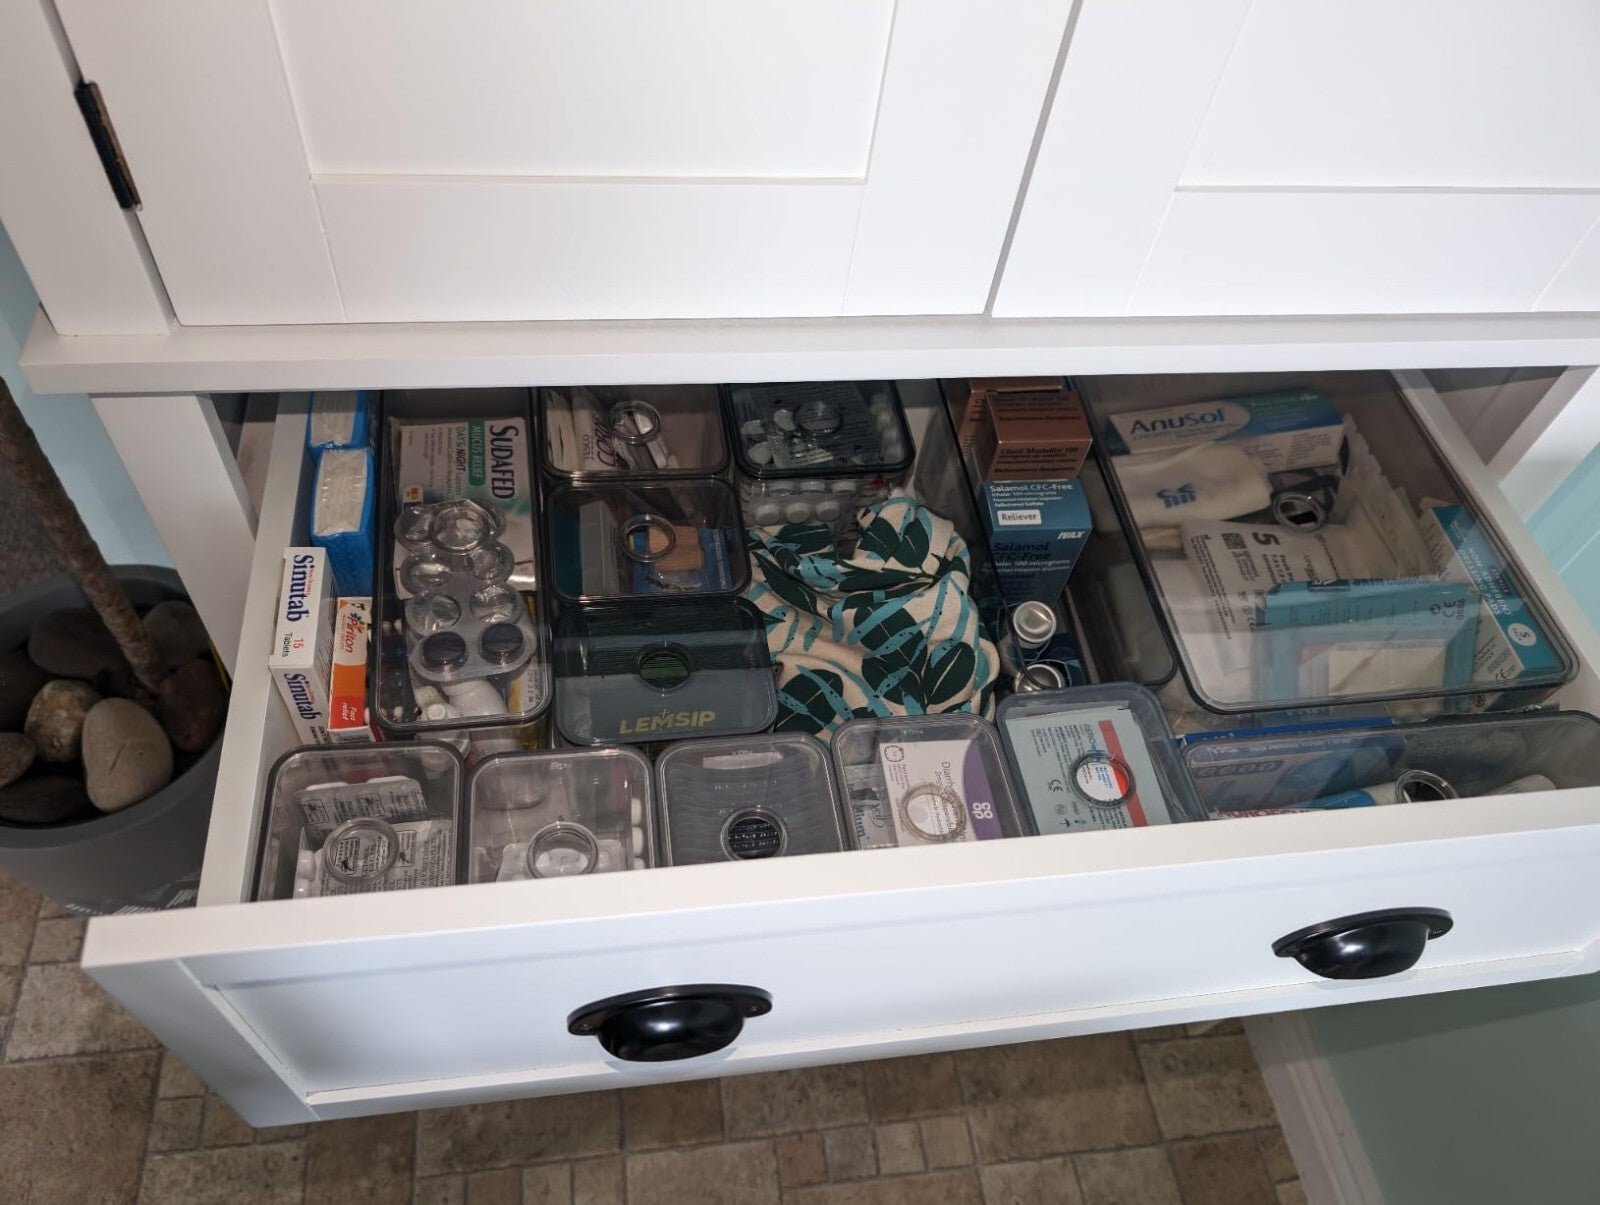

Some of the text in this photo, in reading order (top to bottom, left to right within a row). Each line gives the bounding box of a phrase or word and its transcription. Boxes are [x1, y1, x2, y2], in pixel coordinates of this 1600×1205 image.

[1130, 408, 1226, 434] AnuSol
[456, 448, 466, 472] NIGHT
[469, 425, 484, 479] MUCUS RELIEF
[489, 425, 519, 499] SUDAFED
[990, 483, 1074, 493] Salamol CFC-Free
[1001, 512, 1038, 522] Reliever
[992, 542, 1049, 552] Salamol
[286, 554, 315, 622] Sinutab
[282, 632, 293, 658] Tablets
[293, 638, 304, 648] 15
[345, 616, 359, 653] Piriton
[284, 673, 323, 720] Sinutab
[341, 702, 350, 721] relief
[619, 709, 716, 735] LEMSIP
